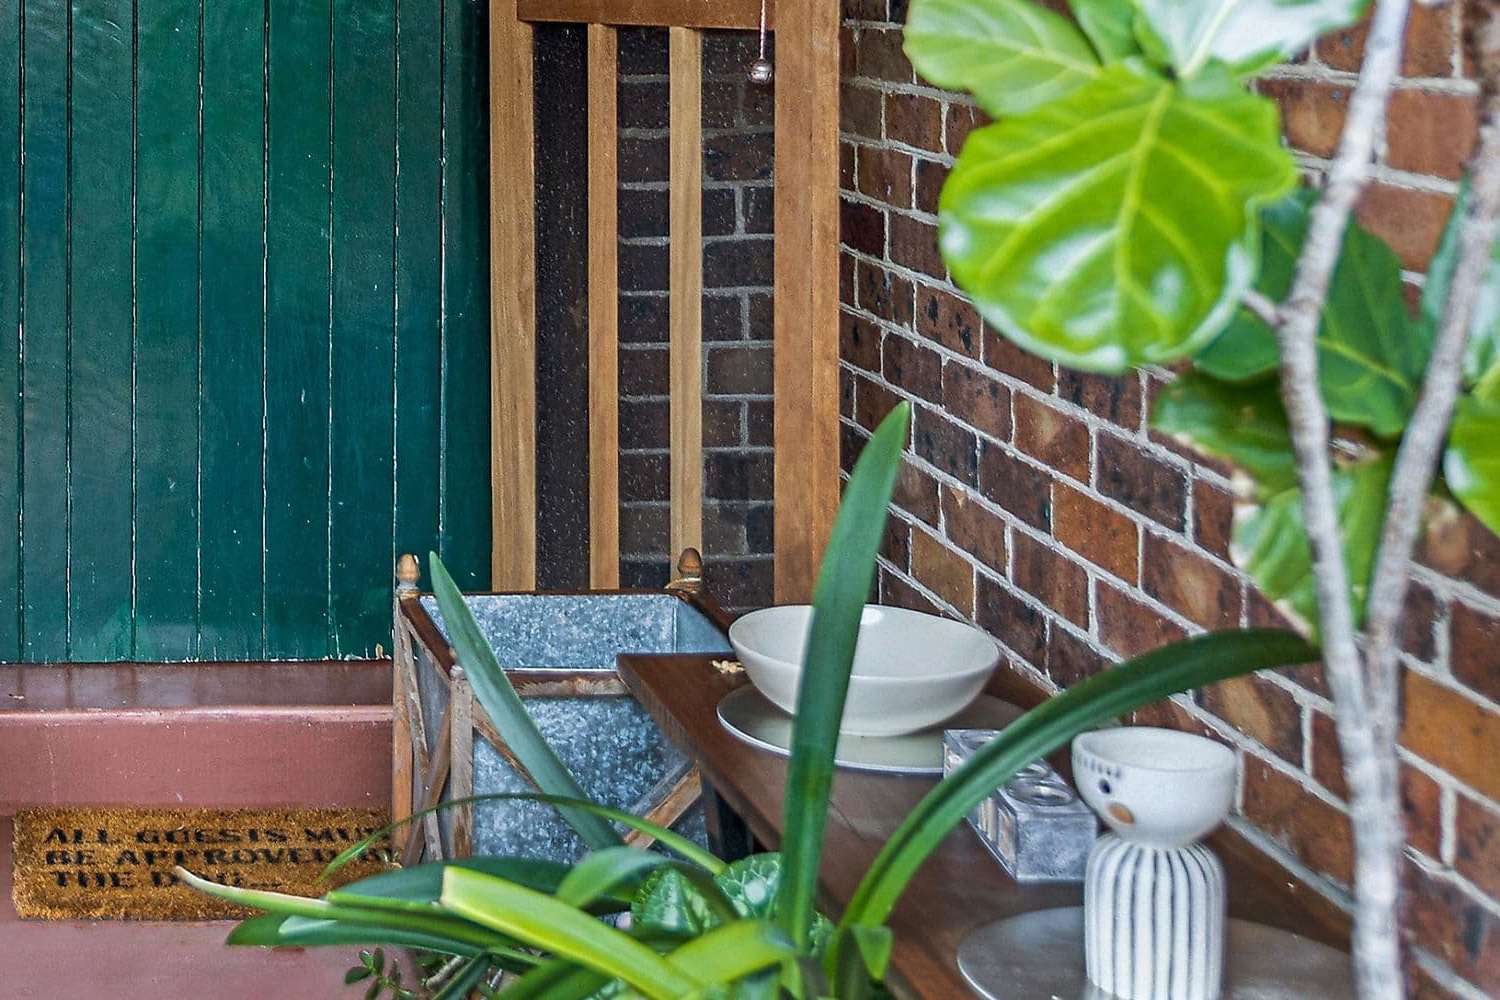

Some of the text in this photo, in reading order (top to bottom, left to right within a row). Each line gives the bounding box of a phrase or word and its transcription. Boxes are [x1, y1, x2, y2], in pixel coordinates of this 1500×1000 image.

[44, 828, 120, 844] ALL
[46, 850, 96, 865] BE
[116, 849, 338, 865] APPROVED
[50, 871, 133, 888] THE
